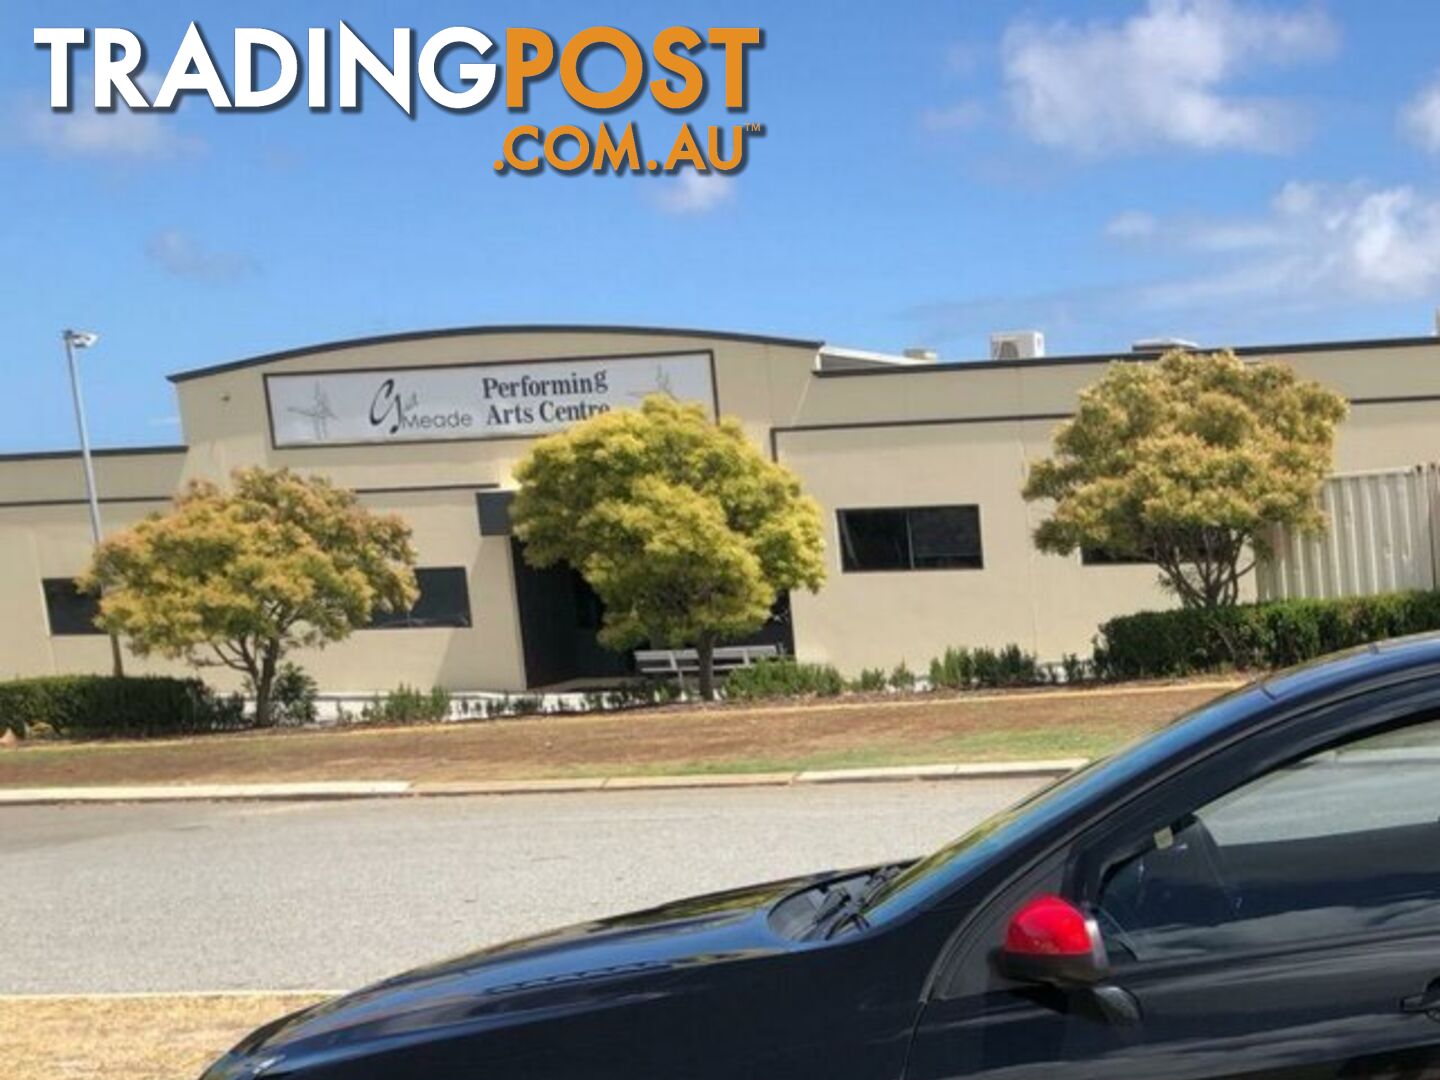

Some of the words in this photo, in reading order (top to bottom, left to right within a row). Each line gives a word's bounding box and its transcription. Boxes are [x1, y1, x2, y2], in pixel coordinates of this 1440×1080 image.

[482, 369, 609, 399] Performing
[401, 410, 473, 429] Meade
[486, 404, 534, 425] Arts
